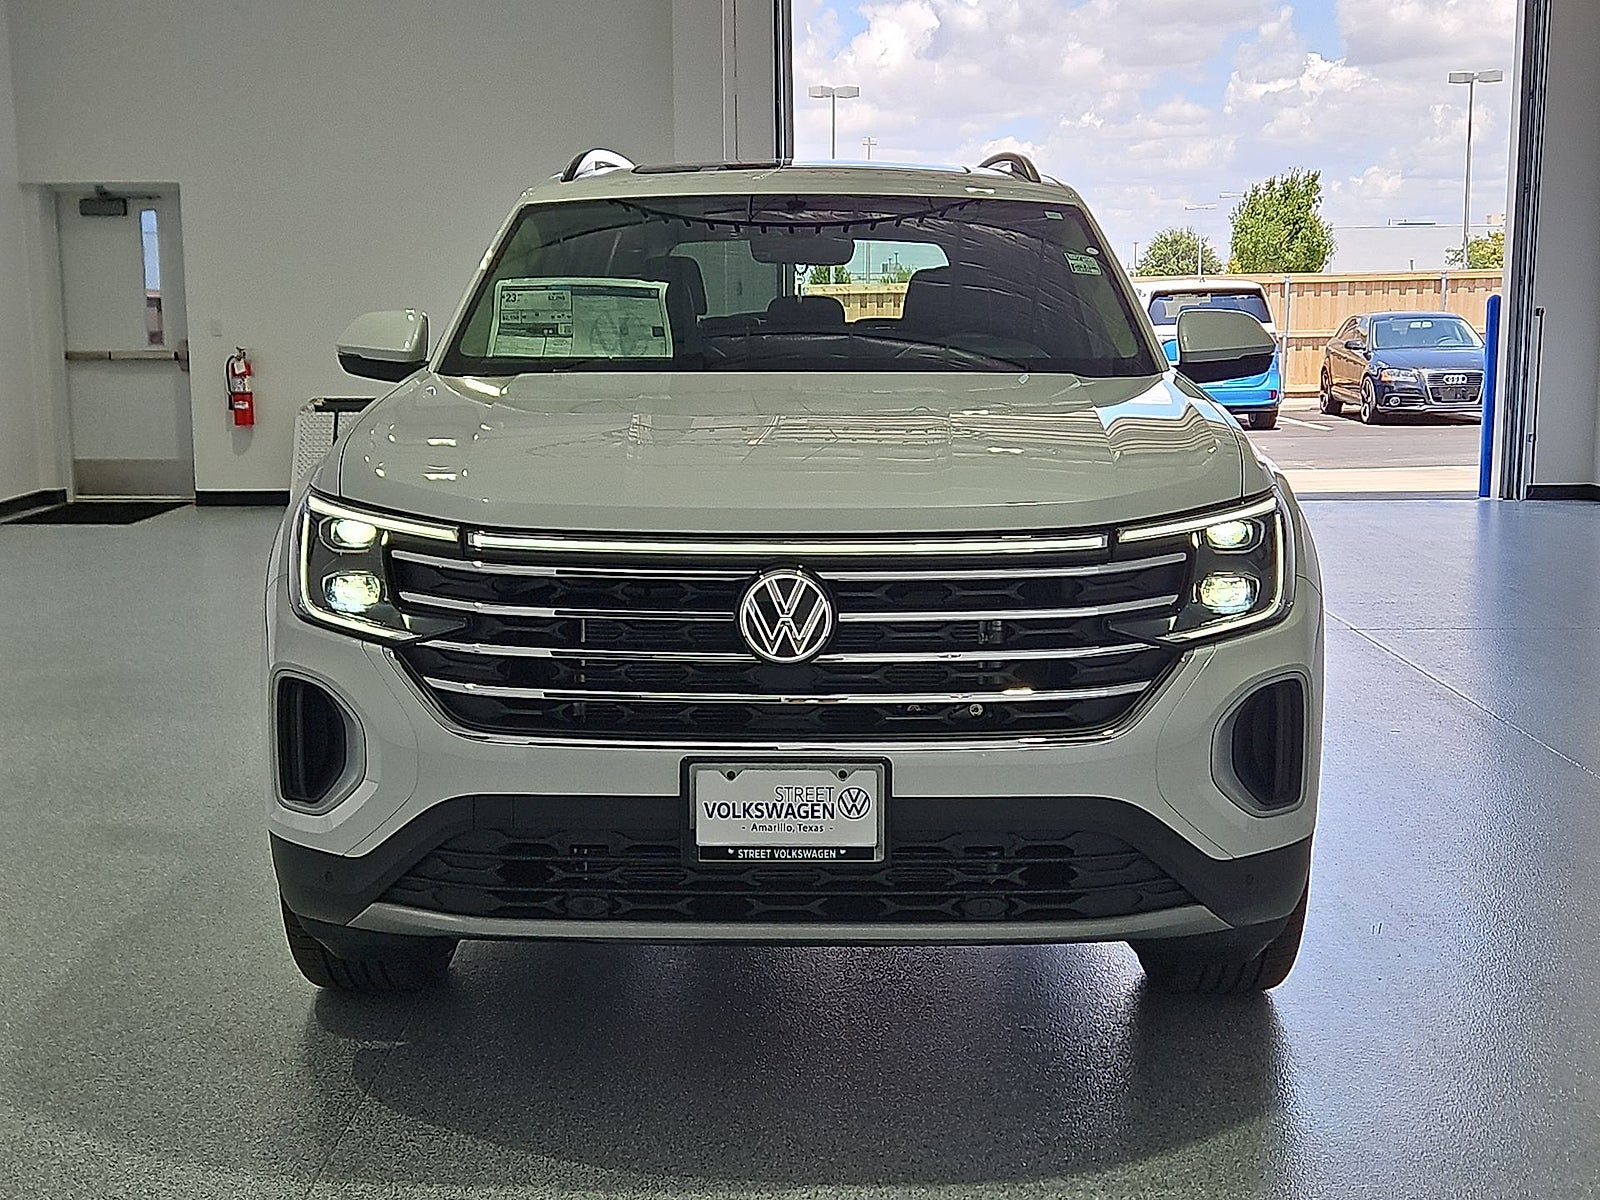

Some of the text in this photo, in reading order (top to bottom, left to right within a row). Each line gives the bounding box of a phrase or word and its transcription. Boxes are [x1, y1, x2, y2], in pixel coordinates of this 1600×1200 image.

[505, 293, 517, 303] 23
[775, 786, 834, 802] STREET
[703, 802, 835, 819] VOLKSWAGEN
[751, 823, 795, 833] Amarillo,
[798, 823, 824, 832] Texas
[738, 849, 836, 859] STREET VOLKSWAGEN
